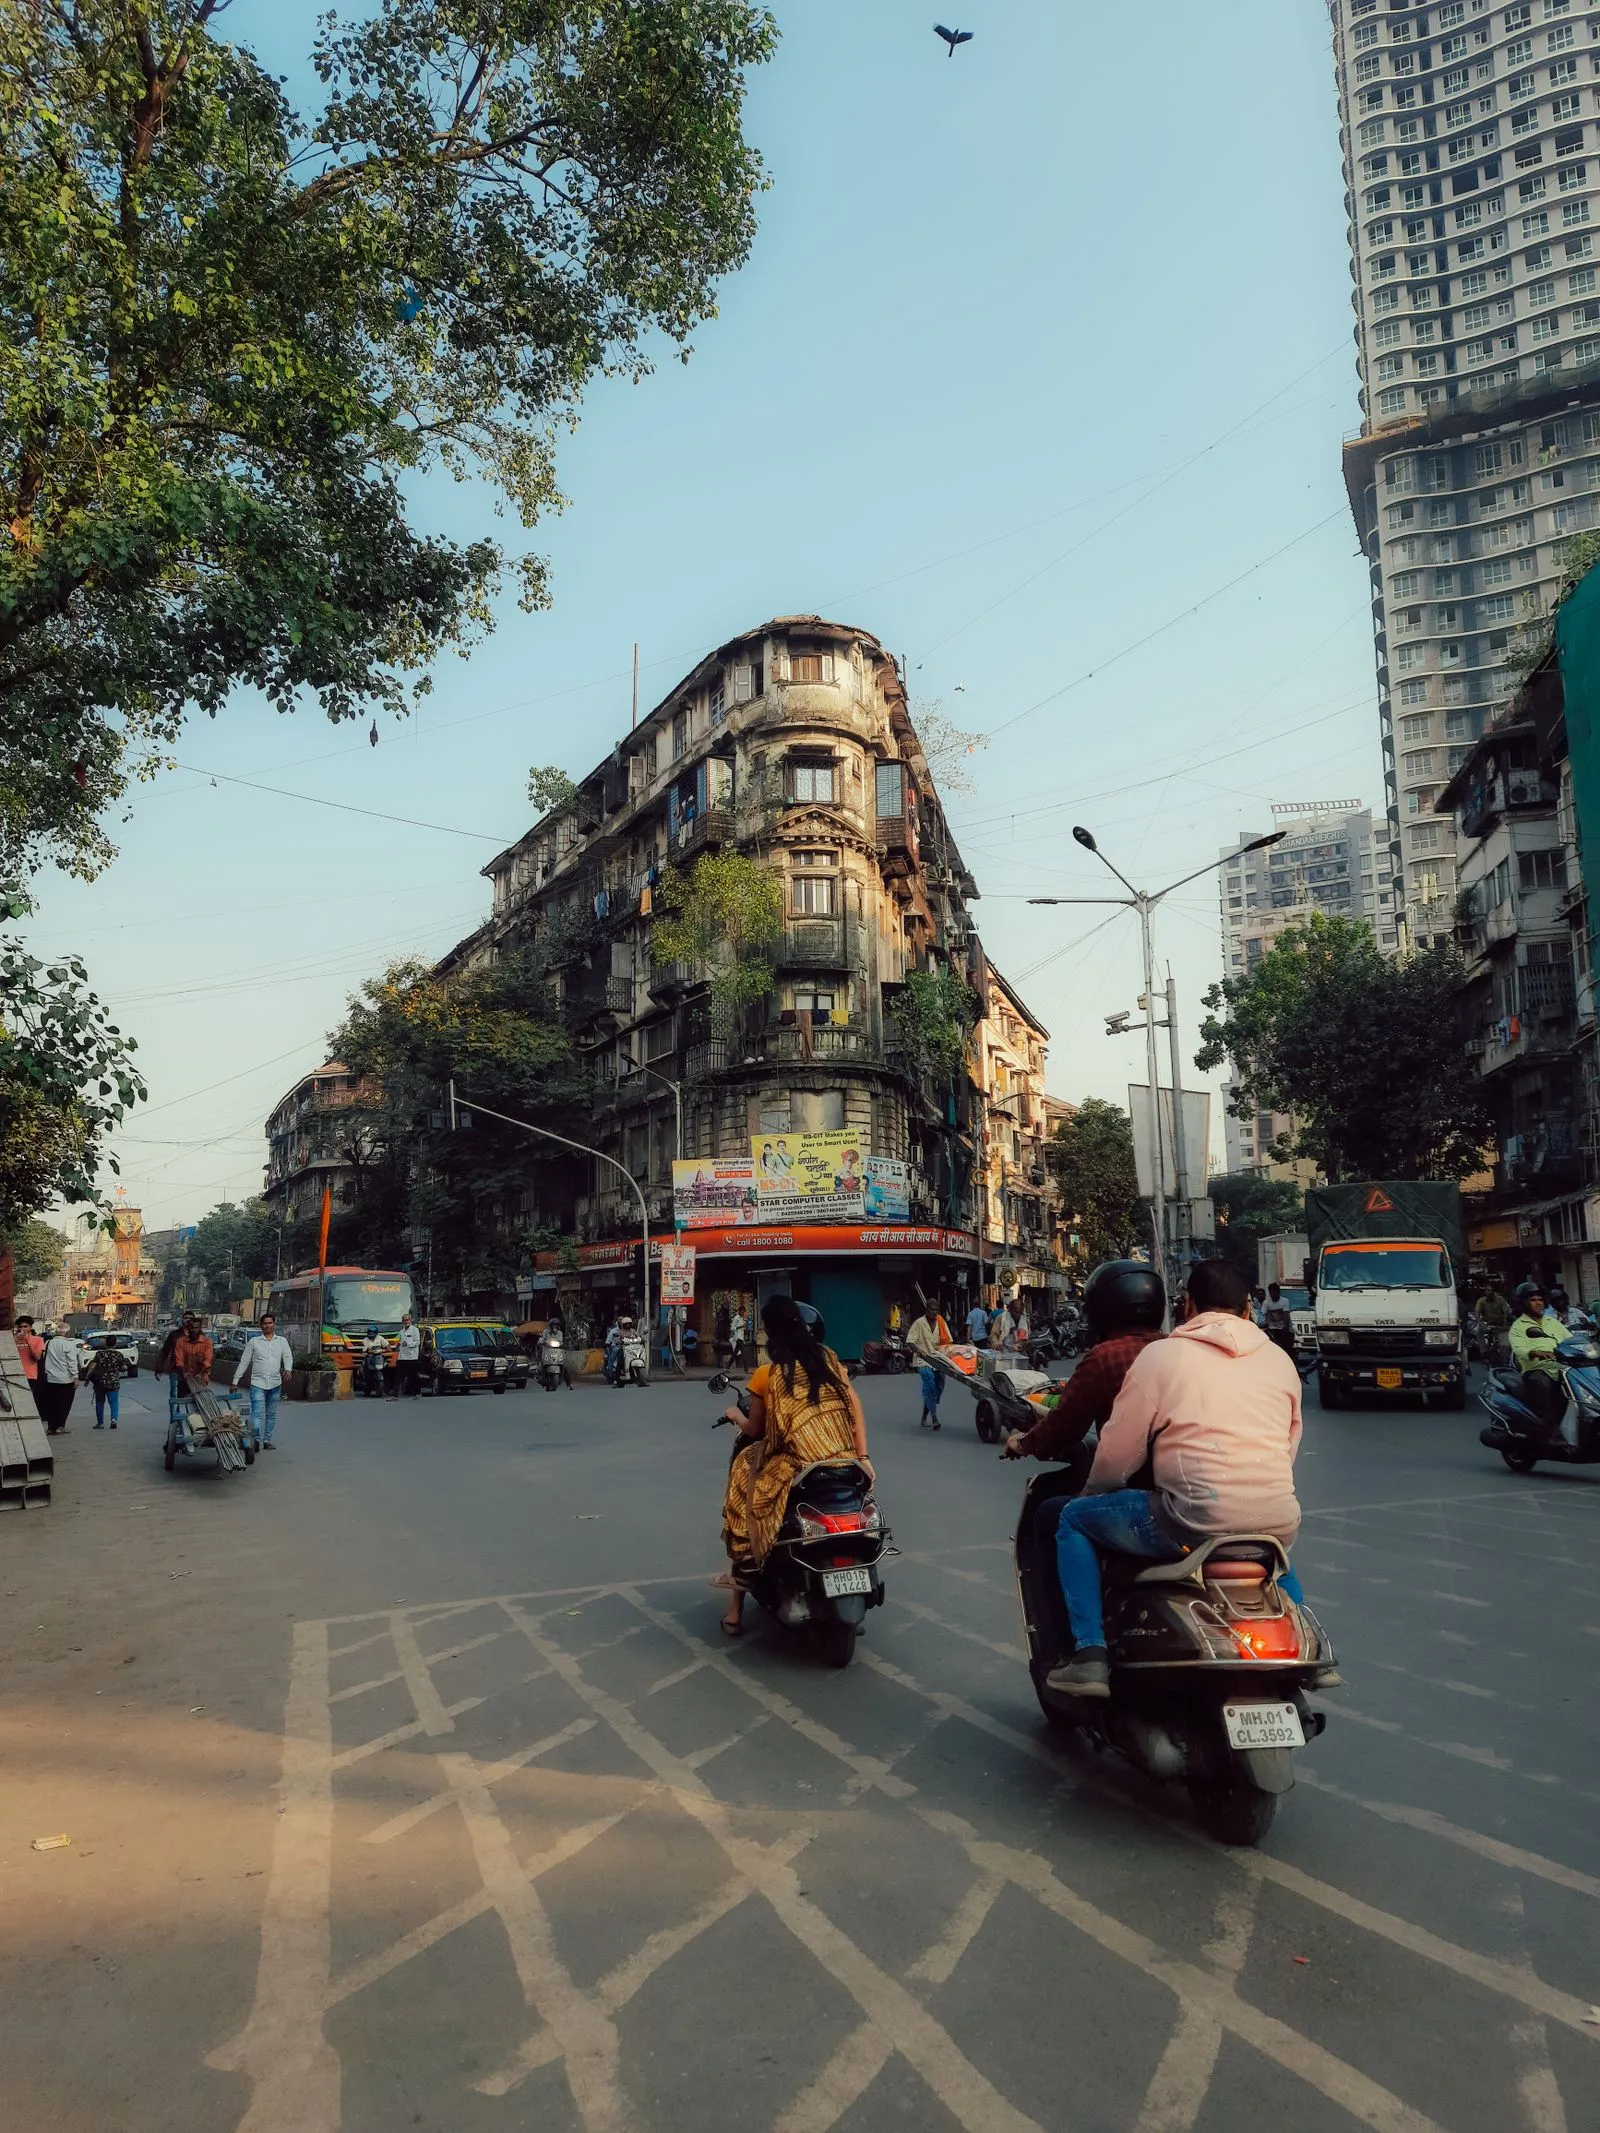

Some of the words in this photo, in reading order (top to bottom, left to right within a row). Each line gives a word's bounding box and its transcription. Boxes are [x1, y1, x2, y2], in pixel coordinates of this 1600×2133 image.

[1314, 831, 1346, 842] HEIGHTS
[760, 1199, 780, 1207] STAR
[782, 1196, 826, 1206] COMPUTER
[827, 1193, 861, 1202] CLASSES
[736, 1238, 751, 1246] call
[752, 1237, 772, 1246] 1800
[773, 1236, 793, 1245] 1080
[860, 1231, 878, 1243] आय
[879, 1227, 889, 1243] सी
[889, 1231, 905, 1243] आय
[906, 1227, 916, 1243] सी
[916, 1231, 932, 1243] आय
[1239, 1710, 1284, 1726] MH.01
[1236, 1727, 1296, 1744] CL.3592
